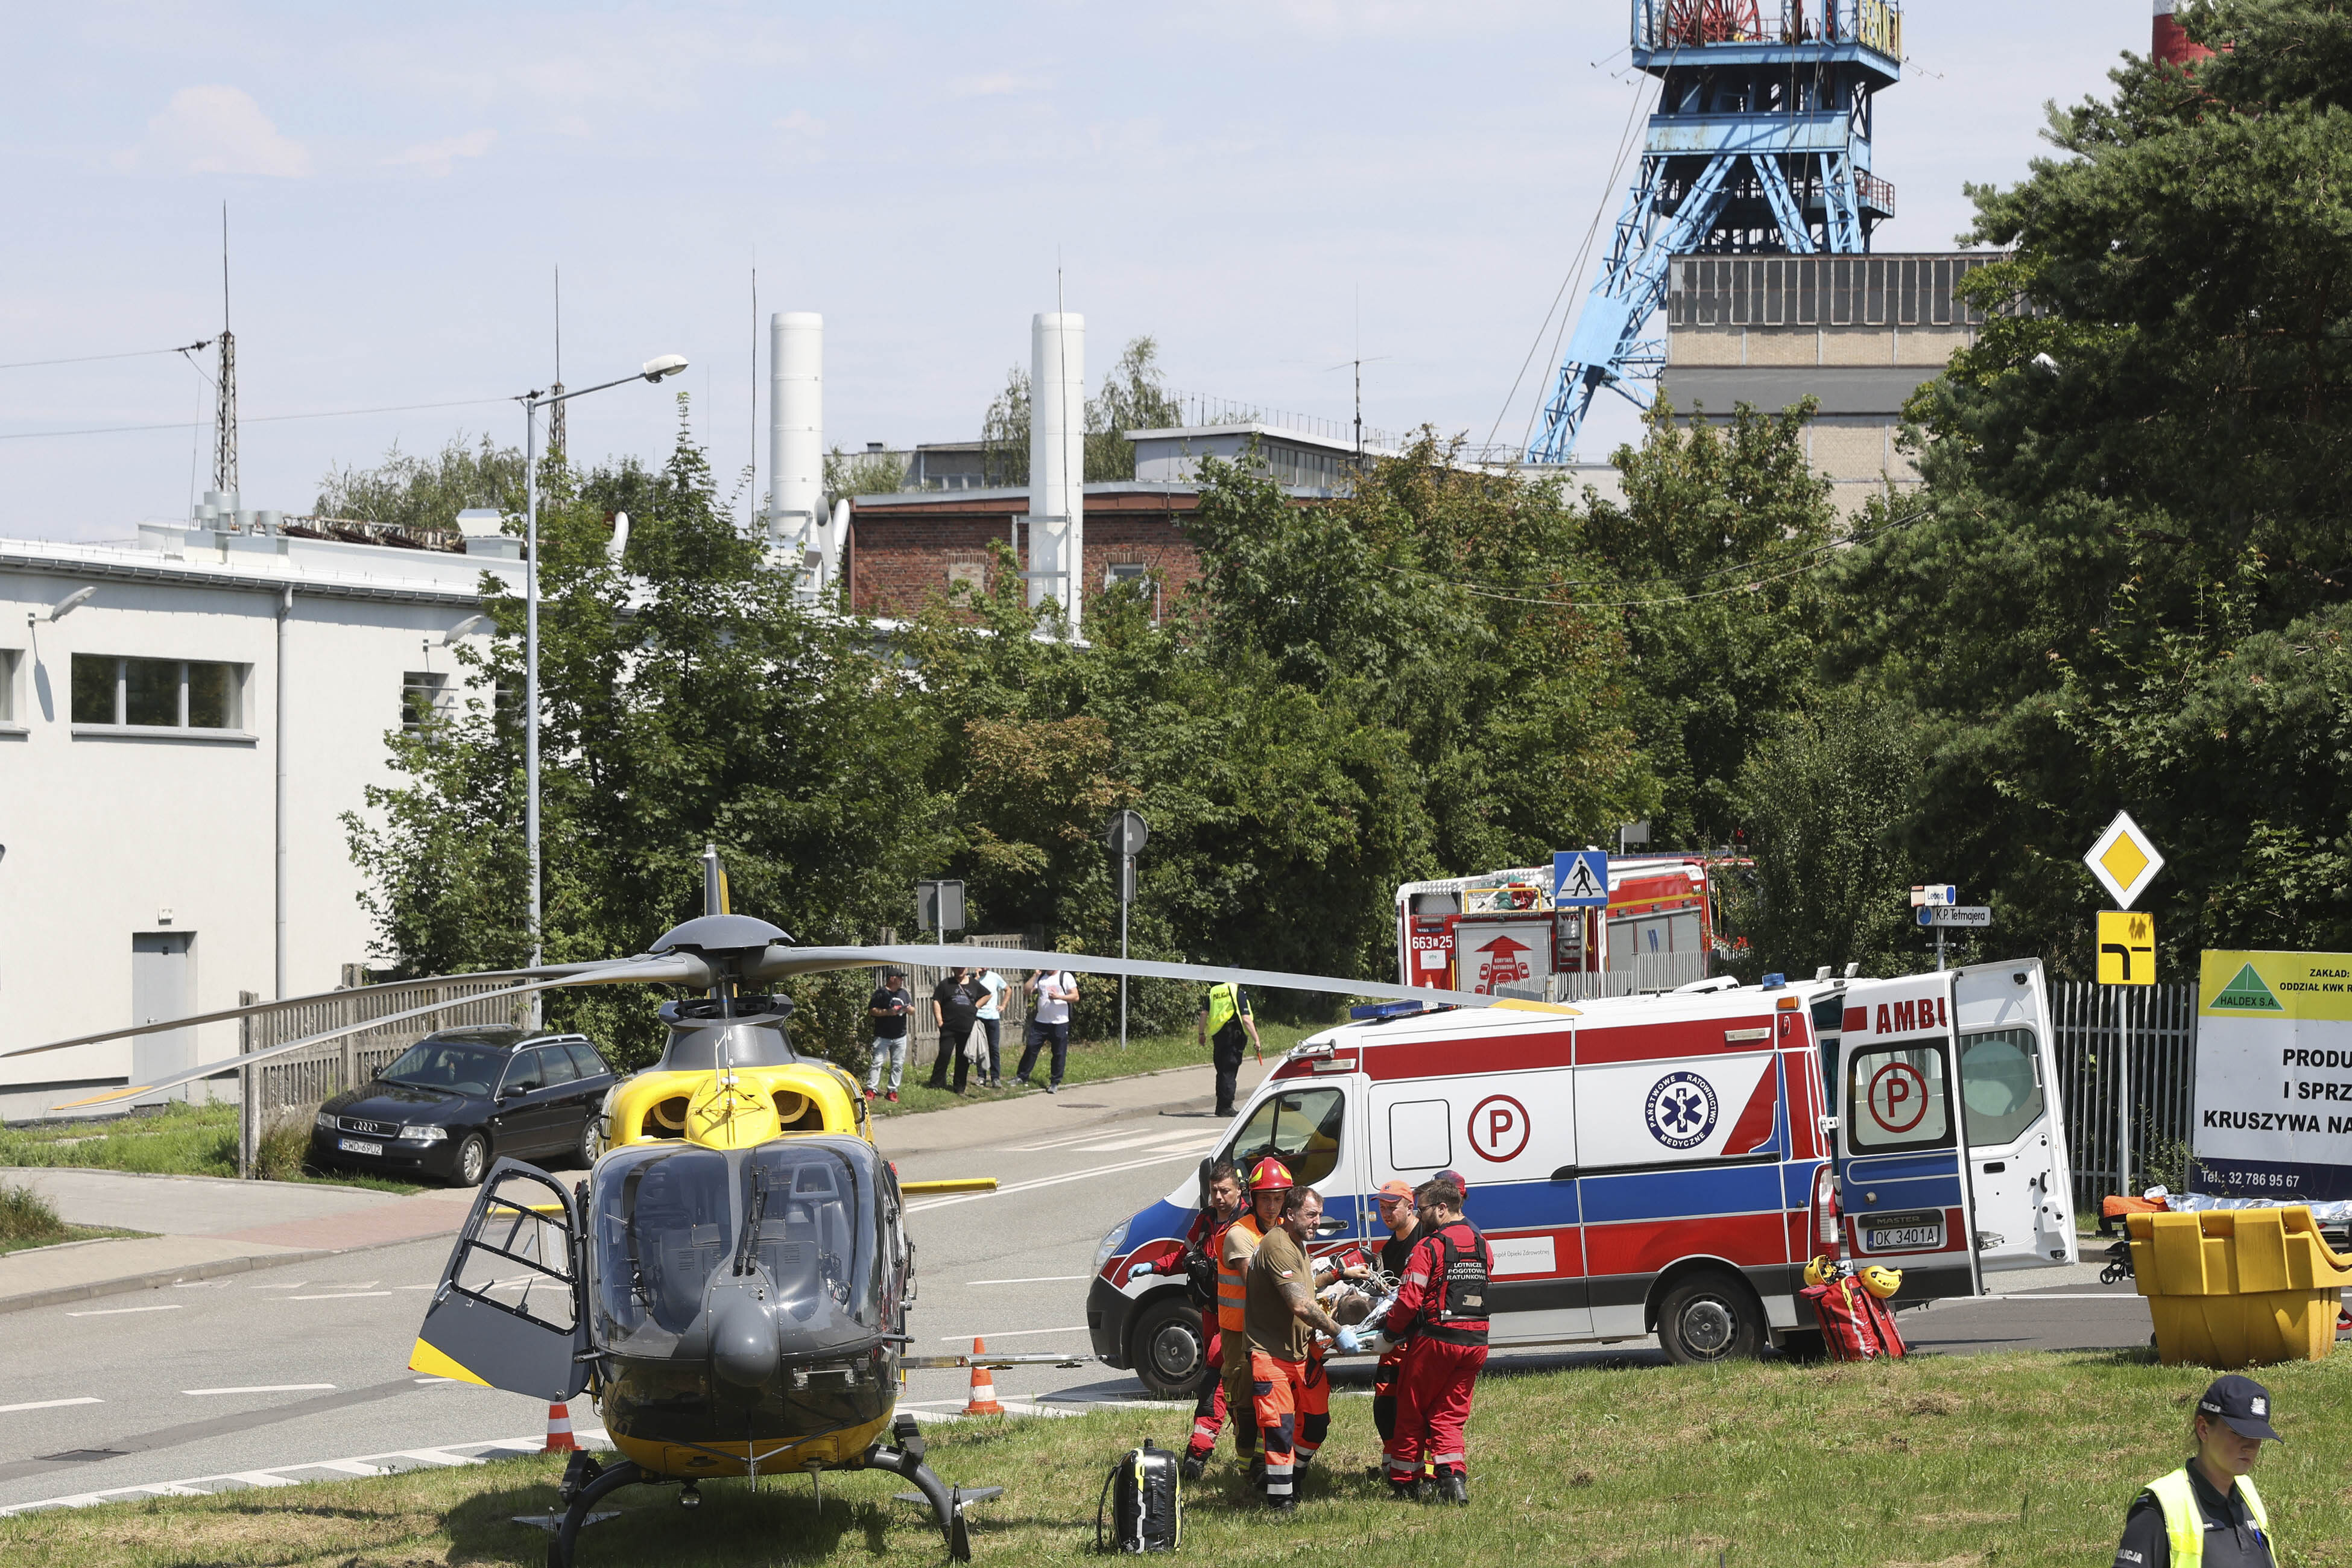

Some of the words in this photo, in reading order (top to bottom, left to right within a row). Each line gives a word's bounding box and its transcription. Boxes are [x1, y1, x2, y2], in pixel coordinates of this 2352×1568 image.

[1927, 890, 1944, 900] Leona
[1936, 909, 1949, 920] K.P.
[1950, 908, 1985, 924] Tetmajera
[2310, 969, 2350, 978] ZAKŁAD:
[2280, 982, 2319, 991] ODDZIAŁ
[2322, 984, 2344, 992] KWK
[2221, 996, 2257, 1007] HALDEX
[2259, 997, 2277, 1007] S.A.
[2283, 1049, 2352, 1069] PRODU
[1886, 1078, 1909, 1118] P
[2284, 1081, 2289, 1099] I
[2298, 1082, 2352, 1101] SPRZ
[1646, 1075, 1676, 1128] PAŃSTWOWE
[1686, 1074, 1716, 1124] RATOWNICTWO
[1490, 1109, 1513, 1147] P
[2204, 1110, 2321, 1133] KRUSZYWA
[2327, 1116, 2352, 1134] NA
[343, 1140, 359, 1151] SWD
[361, 1143, 381, 1154] 69U2
[1660, 1131, 1706, 1147] MEDYCZNE
[2228, 1172, 2242, 1184] 32
[2246, 1173, 2266, 1186] 786
[2269, 1174, 2283, 1187] 95
[2286, 1175, 2300, 1187] 67
[1877, 1216, 1920, 1225] MASTER
[1876, 1231, 1891, 1245] OK
[1896, 1228, 1934, 1244] 3401A
[2117, 1549, 2143, 1564] OLICJA
